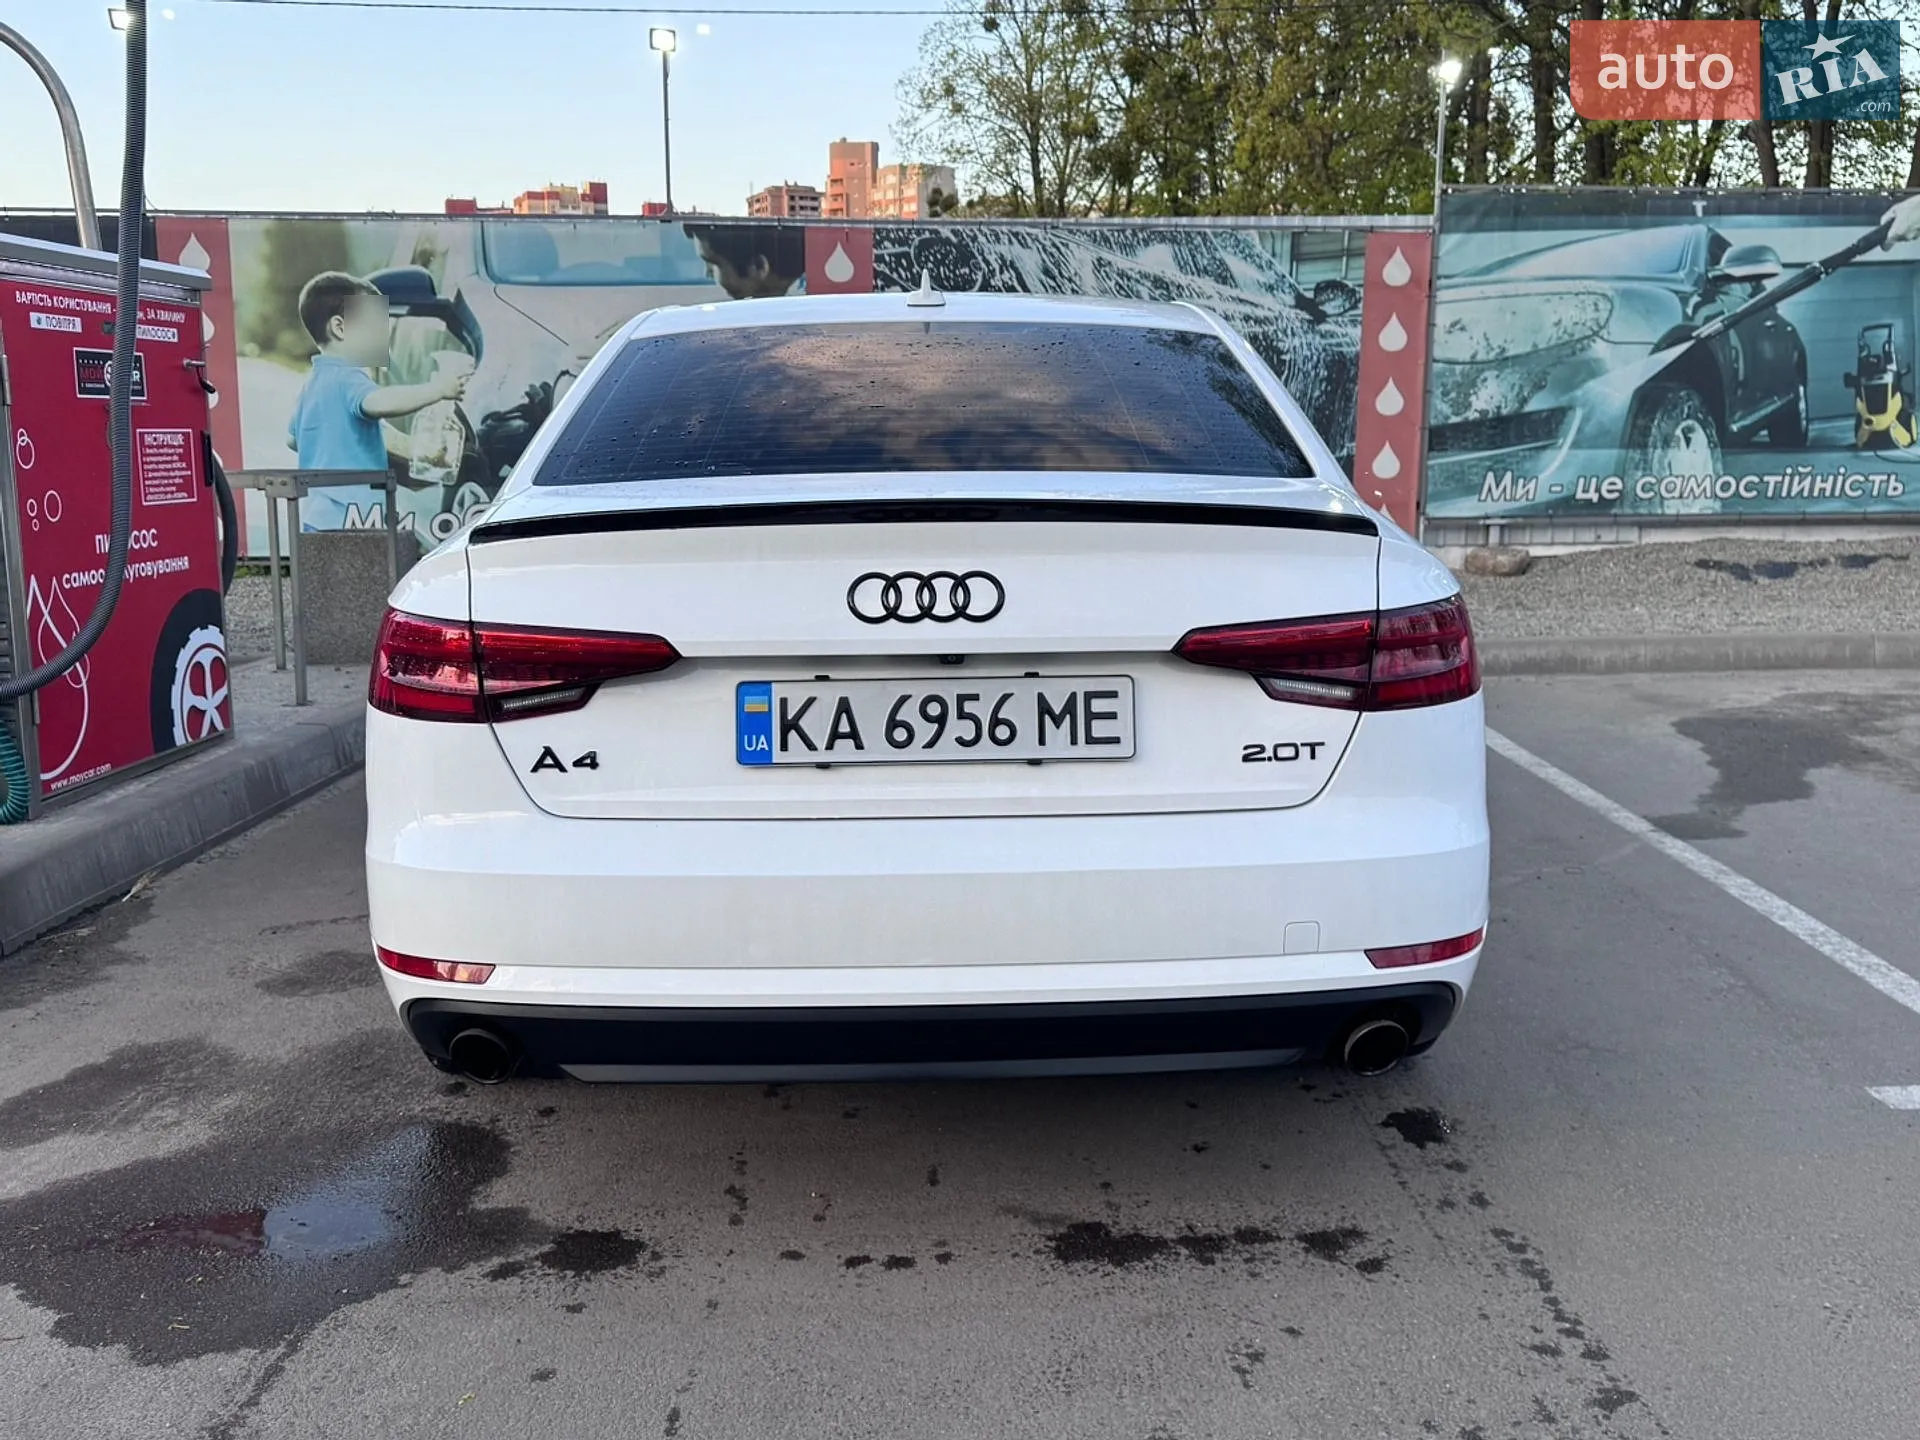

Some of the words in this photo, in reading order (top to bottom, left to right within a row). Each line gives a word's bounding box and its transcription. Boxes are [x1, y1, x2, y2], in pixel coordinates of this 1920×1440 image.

[15, 290, 52, 308] ВАРТІСТЬ
[53, 296, 112, 315] КОРИСТУВАННЯ
[1478, 470, 1540, 501] Ми
[1574, 474, 1624, 504] це
[1636, 465, 1906, 500] самостійність
[778, 695, 865, 752] KA
[884, 692, 1018, 749] 6956
[1037, 690, 1121, 747] ME
[744, 734, 769, 751] UA
[1241, 741, 1325, 763] 2.0T
